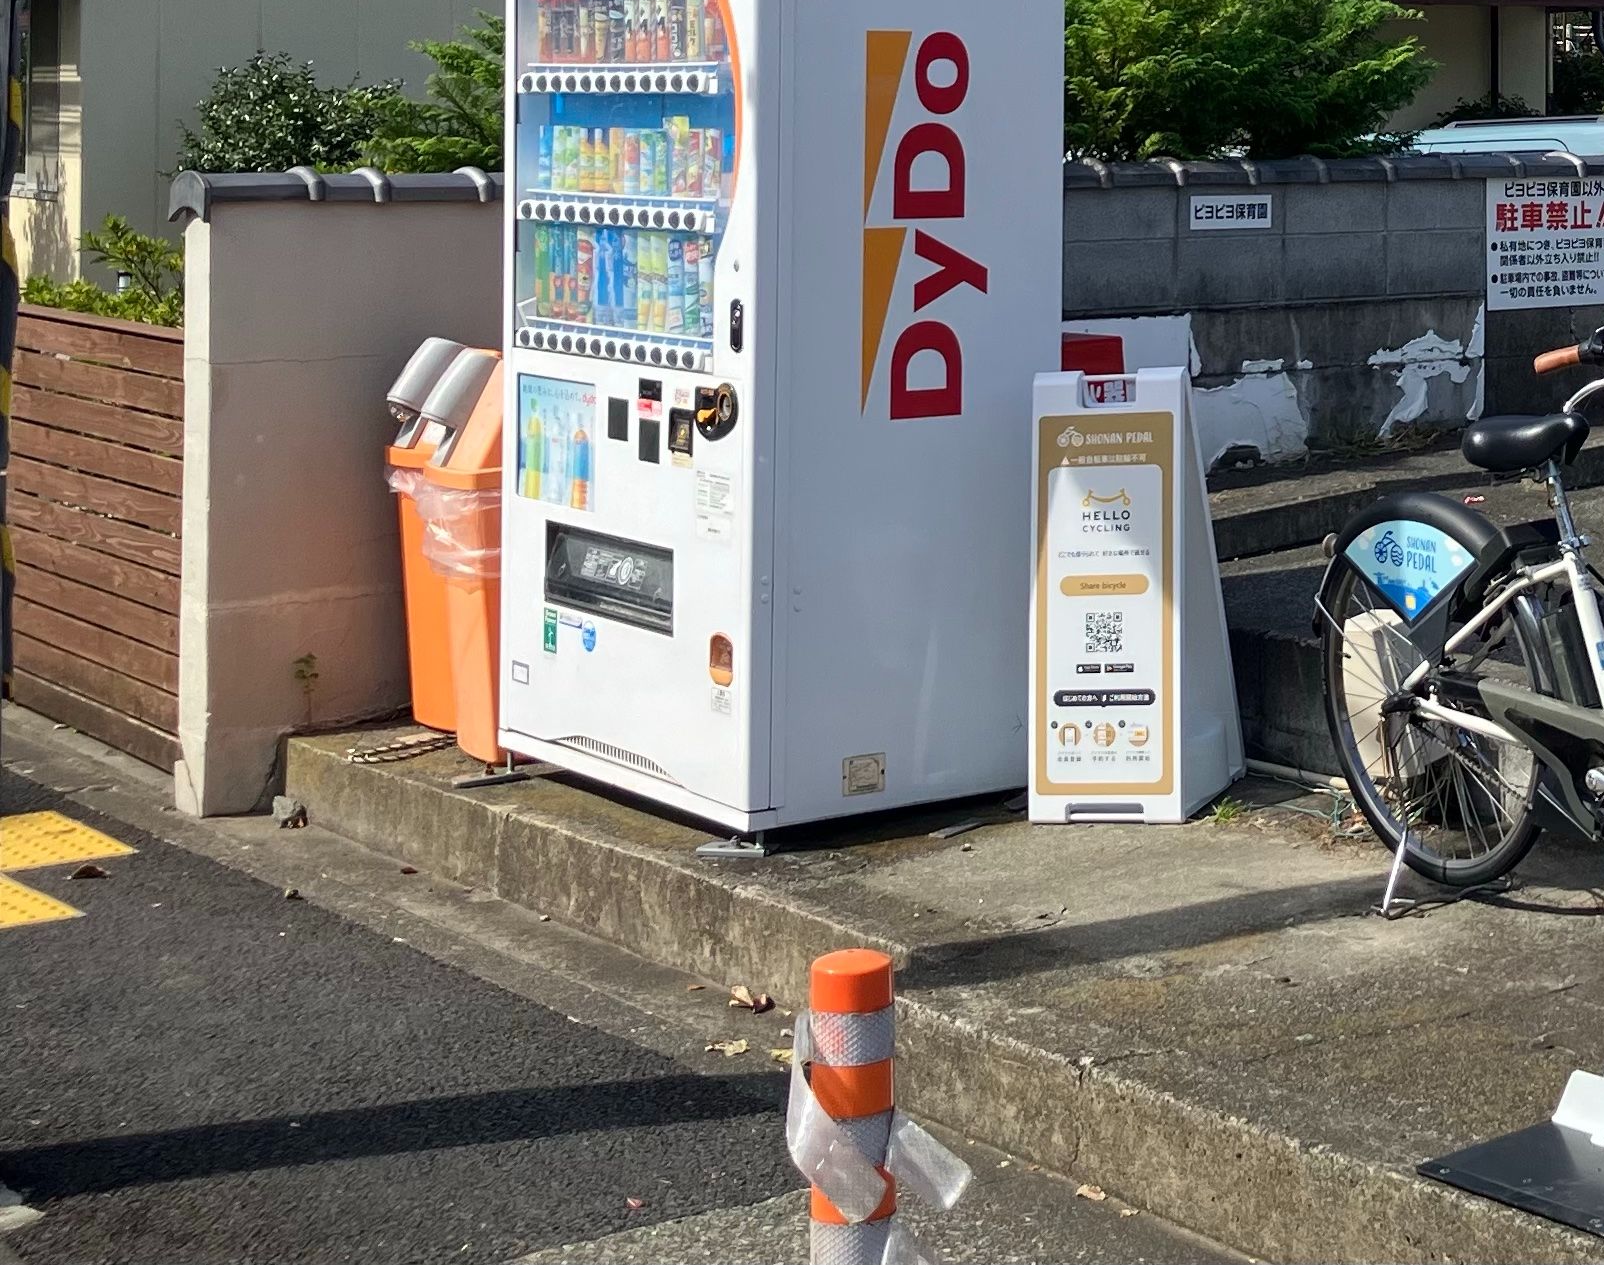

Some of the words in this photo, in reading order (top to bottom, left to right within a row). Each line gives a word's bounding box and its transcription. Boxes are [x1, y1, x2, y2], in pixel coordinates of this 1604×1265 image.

[1505, 181, 1604, 197] ピヨピヨ保育園以外
[1194, 203, 1268, 220] ピヨピヨ保育園
[1500, 285, 1598, 298] 一切の責任を負いません。
[1086, 432, 1122, 445] SHONAN
[1126, 431, 1153, 443] PEDAL
[1082, 509, 1131, 522] HELLO
[1082, 523, 1131, 533] CYCLING
[1407, 536, 1436, 552] SHONAN
[1407, 550, 1437, 573] PEDAL
